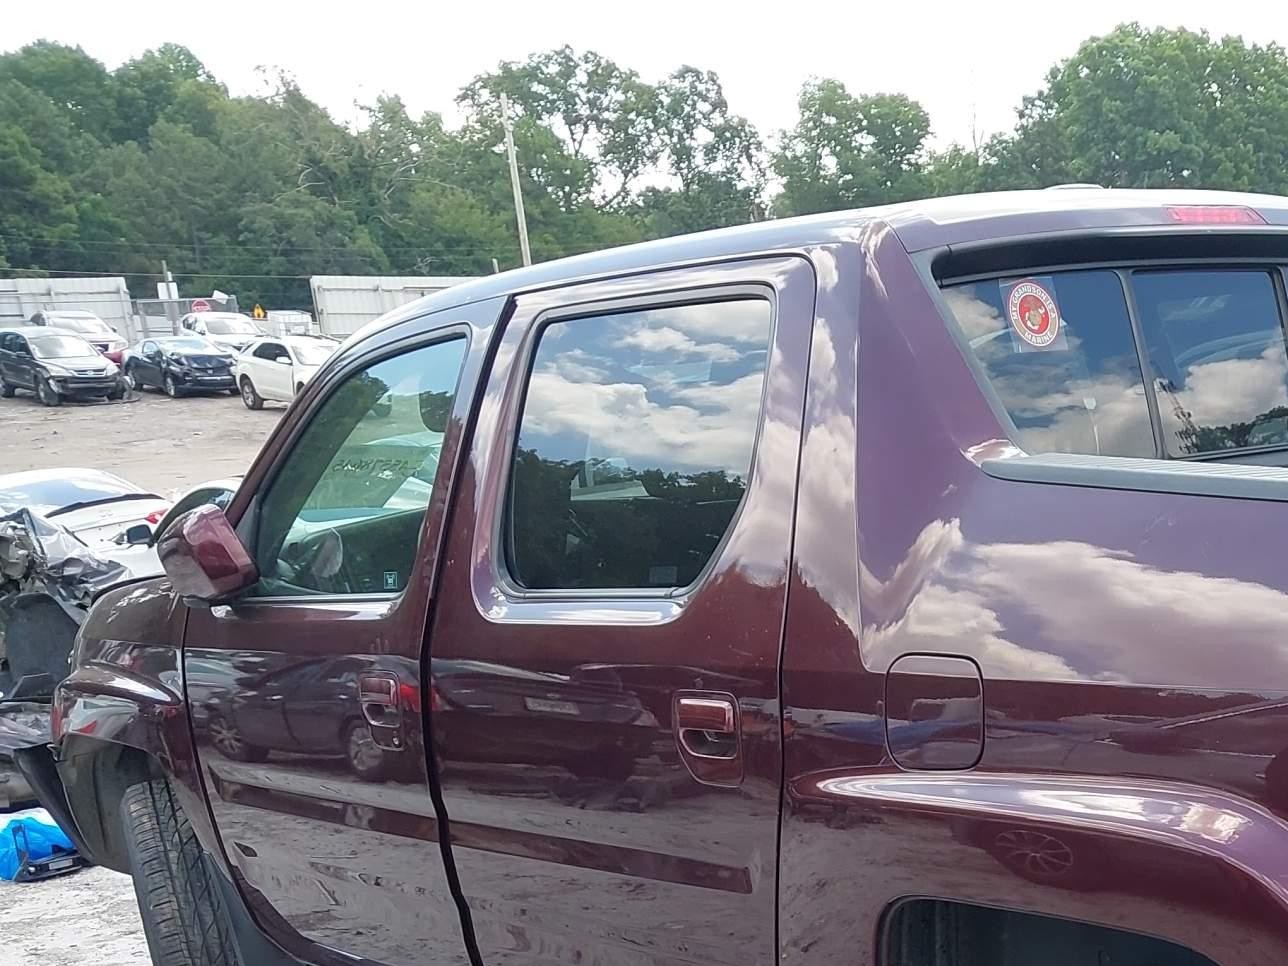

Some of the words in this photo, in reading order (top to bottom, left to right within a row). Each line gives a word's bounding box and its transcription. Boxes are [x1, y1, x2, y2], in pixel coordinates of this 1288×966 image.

[1012, 285, 1047, 304] GRANDSON
[1045, 299, 1054, 310] IS
[1011, 306, 1019, 320] MY
[1024, 331, 1053, 344] MARINE
